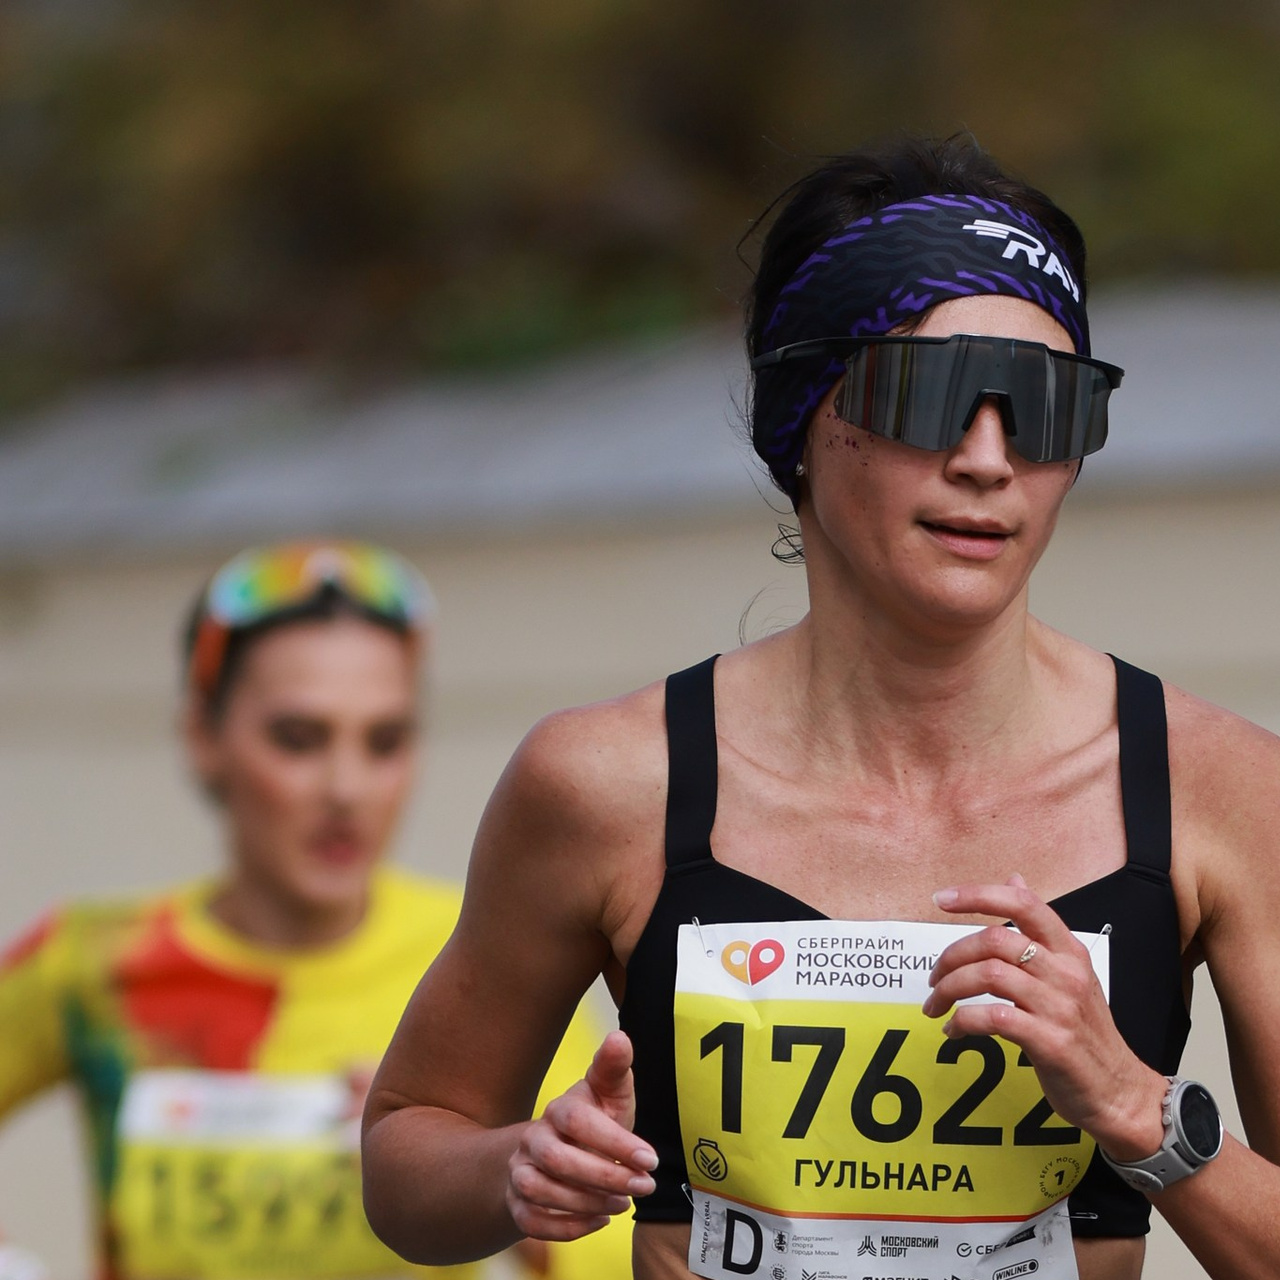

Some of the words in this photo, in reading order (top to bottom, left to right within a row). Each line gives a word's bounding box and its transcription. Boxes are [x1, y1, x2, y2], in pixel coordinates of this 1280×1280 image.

[797, 936, 904, 951] СБЕРПРАЙМ
[795, 971, 903, 988] МАРАФОН
[699, 1021, 1082, 1147] 17622
[794, 1158, 975, 1193] ГУЛЬНАРА
[1054, 1169, 1065, 1186] 1
[701, 1232, 709, 1264] КЛАСТЕР
[722, 1207, 763, 1275] D
[880, 1235, 939, 1249] МОСКОВСКИЙ
[880, 1247, 908, 1258] СПОРТ
[995, 1263, 1028, 1280] WINLINE
